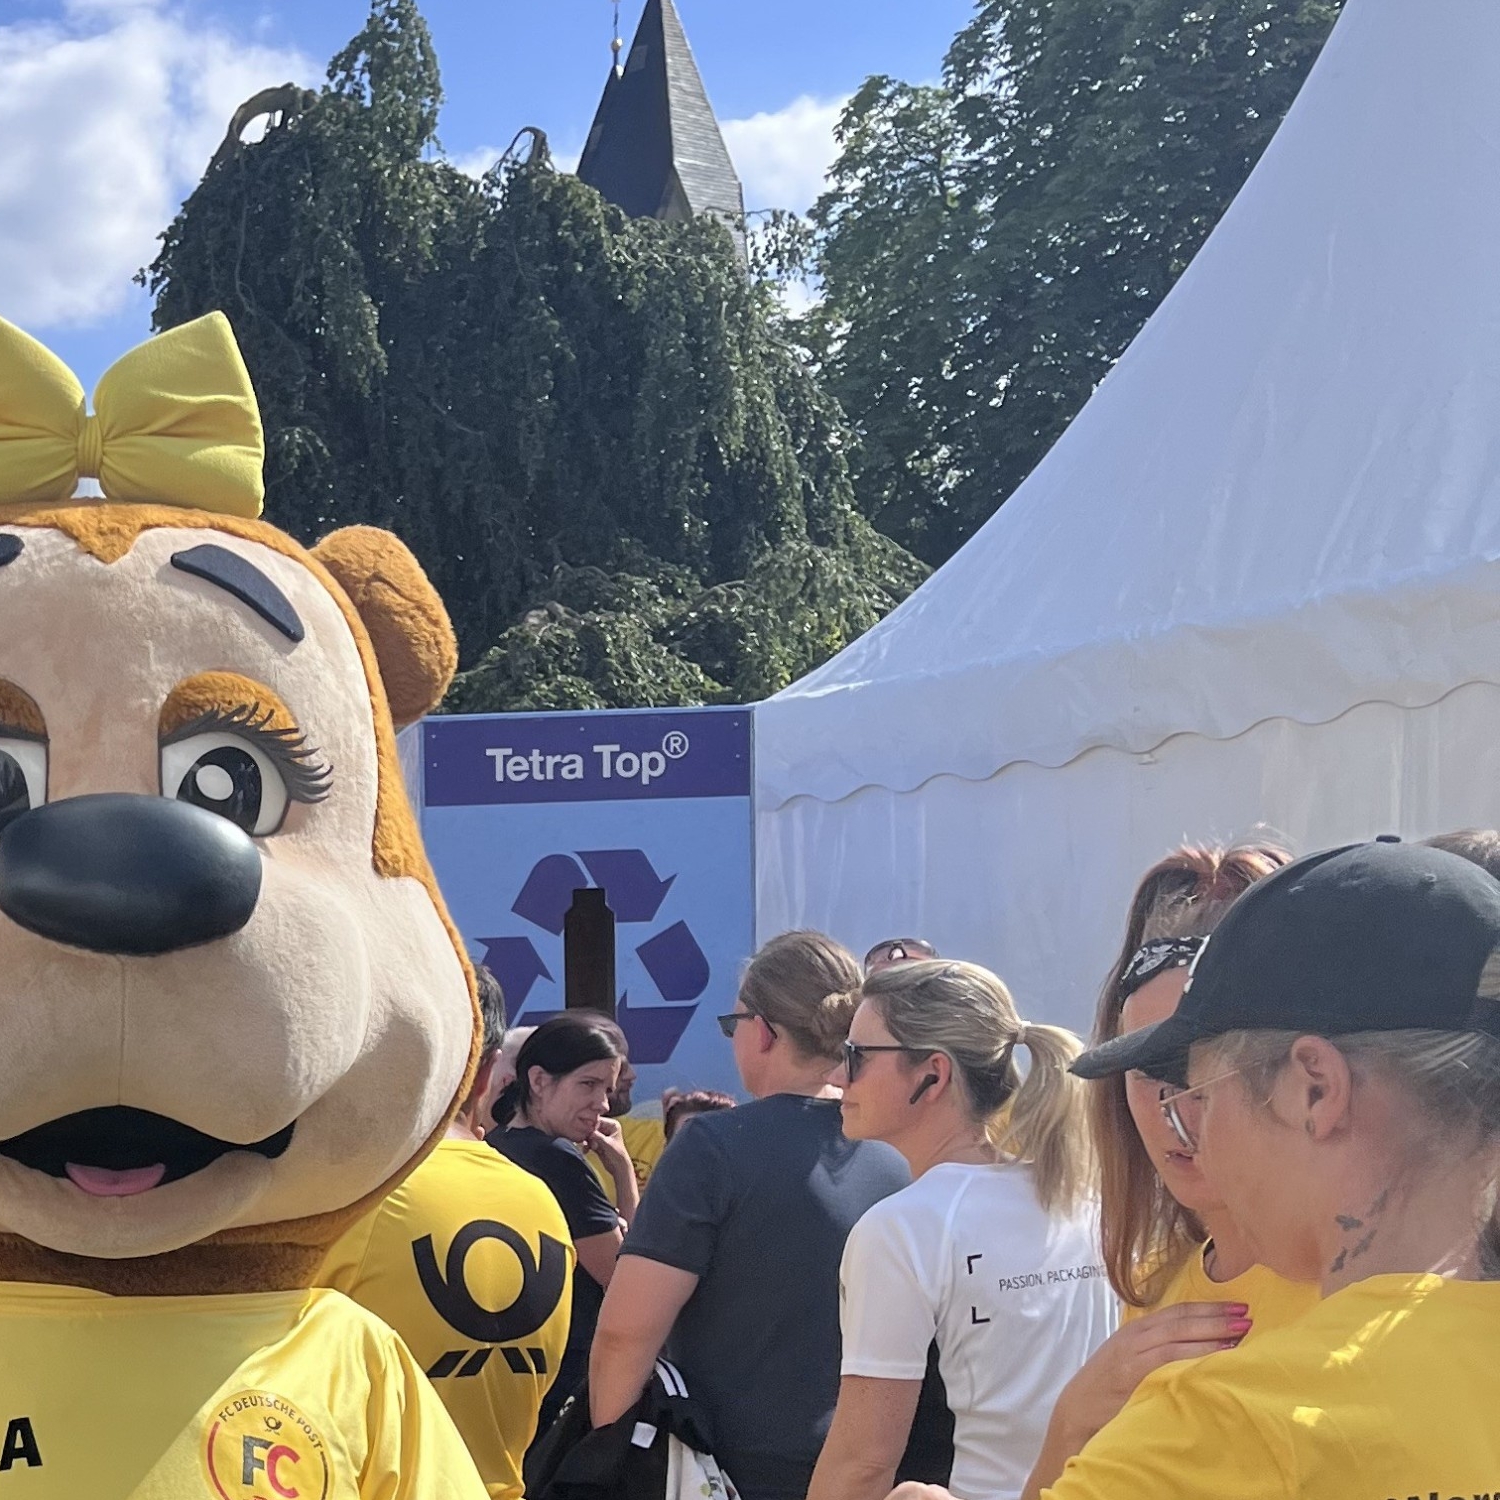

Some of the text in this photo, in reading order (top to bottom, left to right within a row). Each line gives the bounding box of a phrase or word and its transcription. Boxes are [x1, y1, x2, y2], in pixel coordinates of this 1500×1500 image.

[485, 747, 584, 782] Tetra
[218, 1395, 323, 1449] FC DEUTSCHE POST
[242, 1434, 301, 1499] FC
